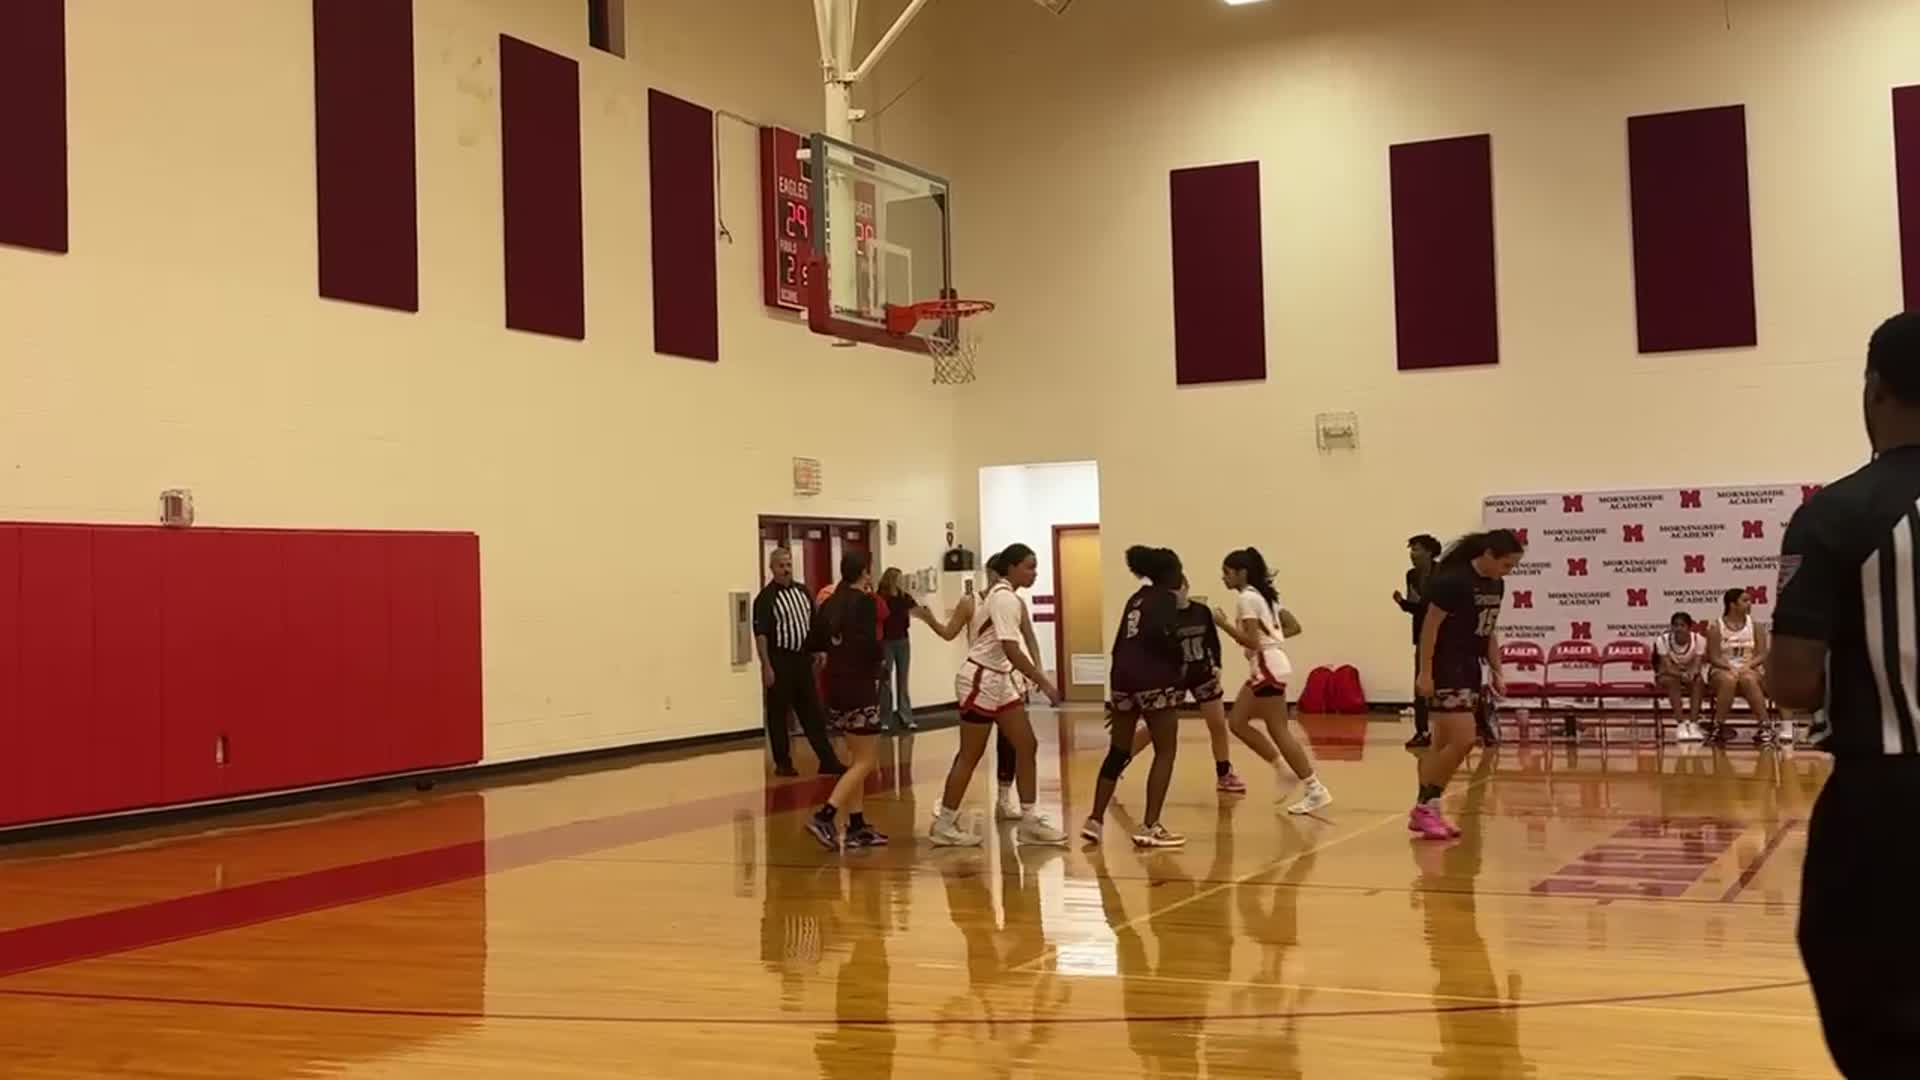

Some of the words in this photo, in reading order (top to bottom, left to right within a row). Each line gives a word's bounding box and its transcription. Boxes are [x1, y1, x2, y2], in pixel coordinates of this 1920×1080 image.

[779, 176, 808, 200] EAGLES
[786, 202, 808, 238] 29
[786, 256, 796, 284] 2
[1717, 489, 1784, 498] MORNINGSIDE
[1484, 499, 1547, 507] MORNINGSIDE
[1598, 495, 1664, 504] MORNINGSIDE
[1680, 489, 1701, 508] M
[1728, 497, 1774, 505] ACADEMY
[1562, 495, 1584, 513] M
[1609, 502, 1653, 510] ACADEMY
[1543, 528, 1608, 536] MORNINGSIDE
[1659, 524, 1725, 532] MORNINGSIDE
[1742, 520, 1764, 539] M
[1622, 524, 1644, 542] M
[1671, 531, 1715, 539] ACADEMY
[1567, 558, 1588, 576] M
[1602, 559, 1668, 567] MORNINGSIDE
[1684, 555, 1705, 573] M
[1732, 562, 1778, 570] ACADEMY
[1613, 566, 1657, 574] ACADEMY
[1512, 591, 1533, 609] M
[1626, 588, 1648, 607] M
[1674, 596, 1718, 604] ACADEMY
[1570, 621, 1592, 640] M
[1503, 647, 1539, 656] EAGLES
[1557, 646, 1592, 655] EAGLES
[1608, 646, 1645, 655] EAGLES
